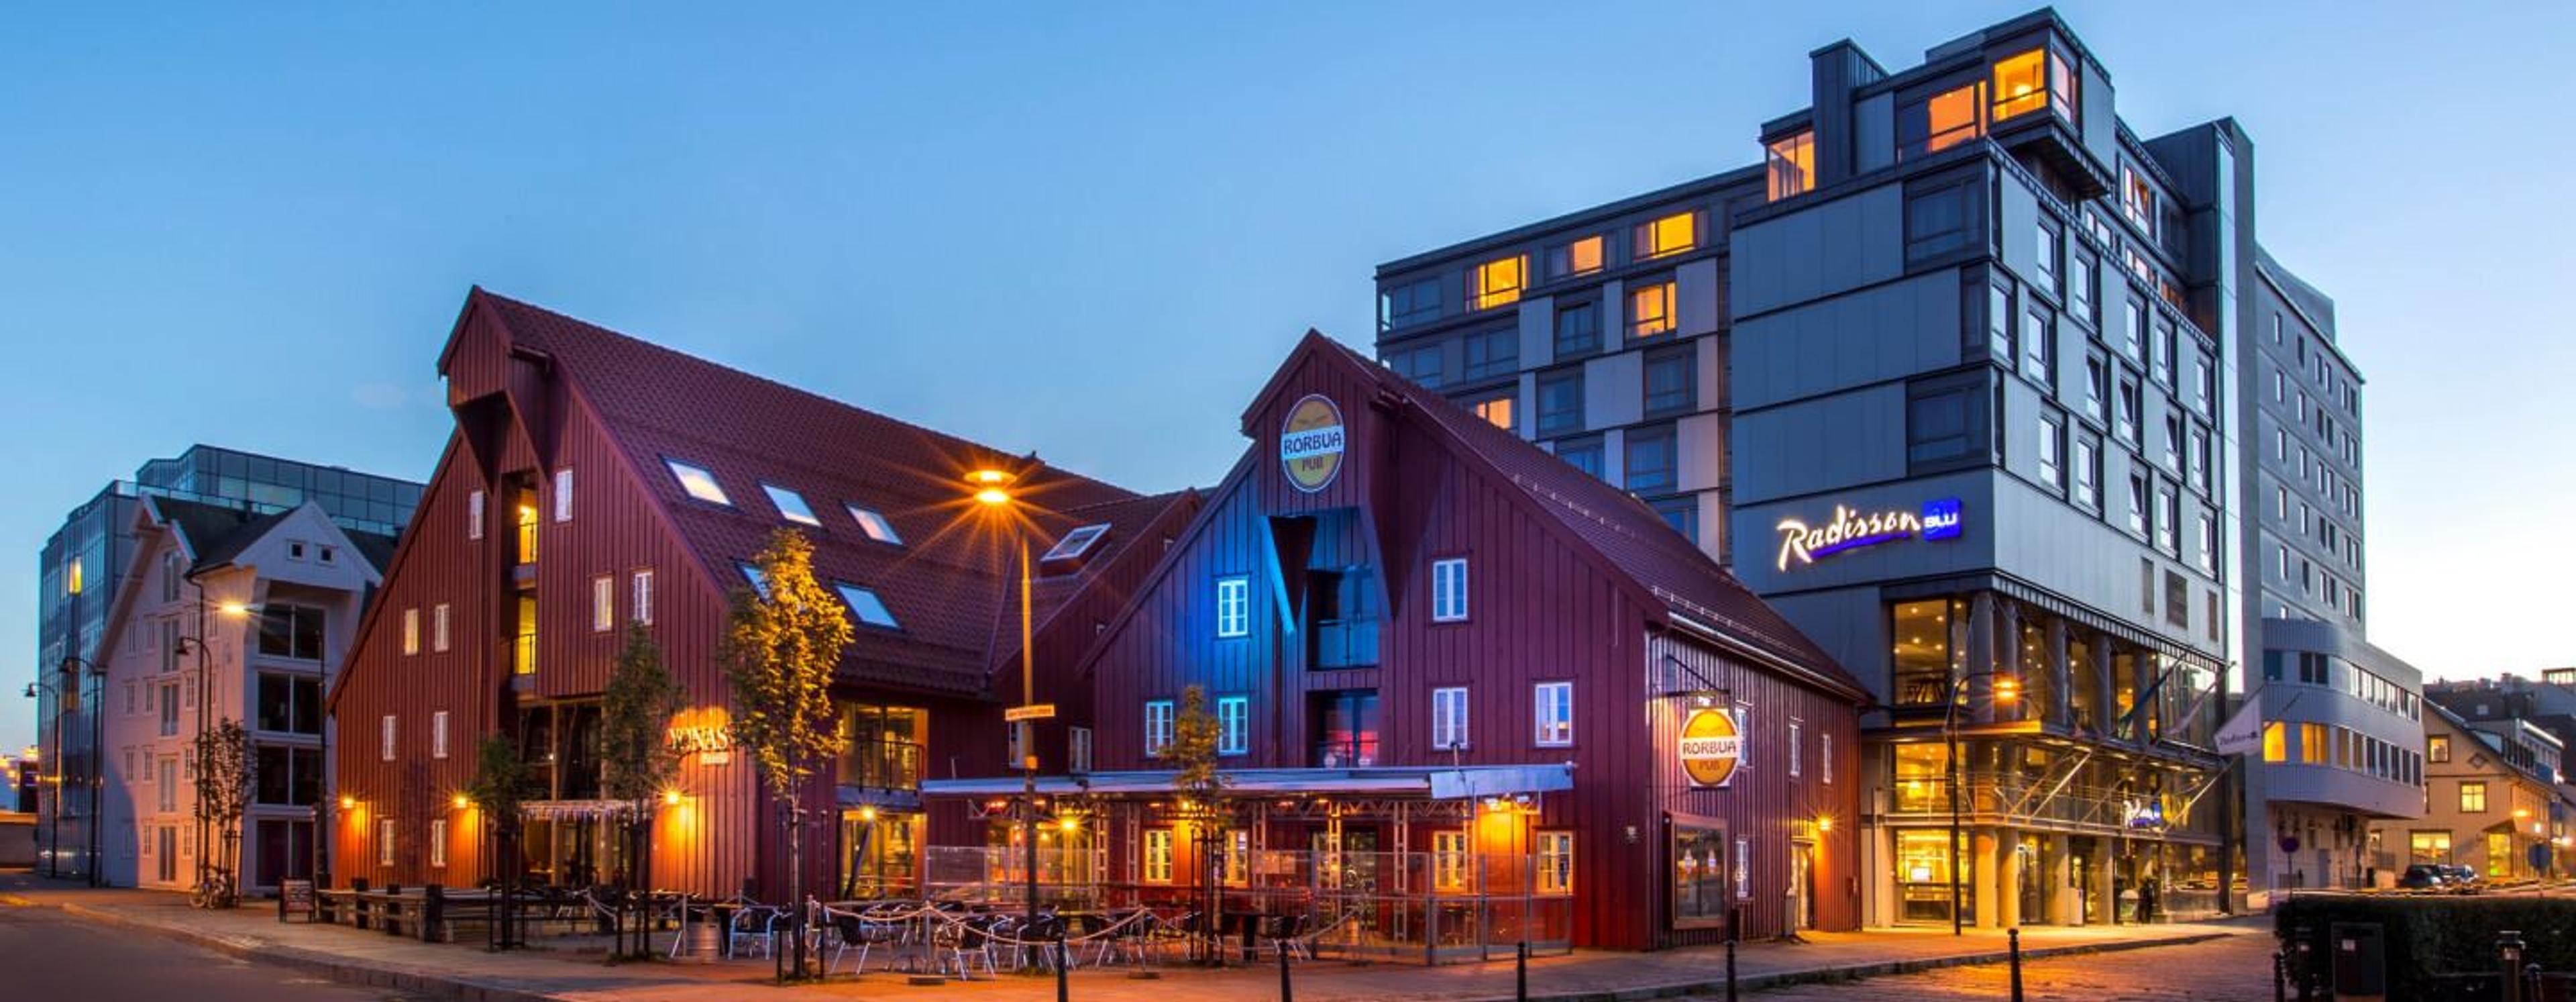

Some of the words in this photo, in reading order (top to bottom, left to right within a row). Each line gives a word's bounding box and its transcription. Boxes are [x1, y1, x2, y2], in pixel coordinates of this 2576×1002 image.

[1284, 432, 1341, 454] RORBUA
[1302, 456, 1324, 471] PUB
[1777, 505, 1921, 572] Radisson
[1924, 513, 1958, 528] BLU
[1682, 740, 1736, 755] RORBUA
[1699, 759, 1720, 770] PUB
